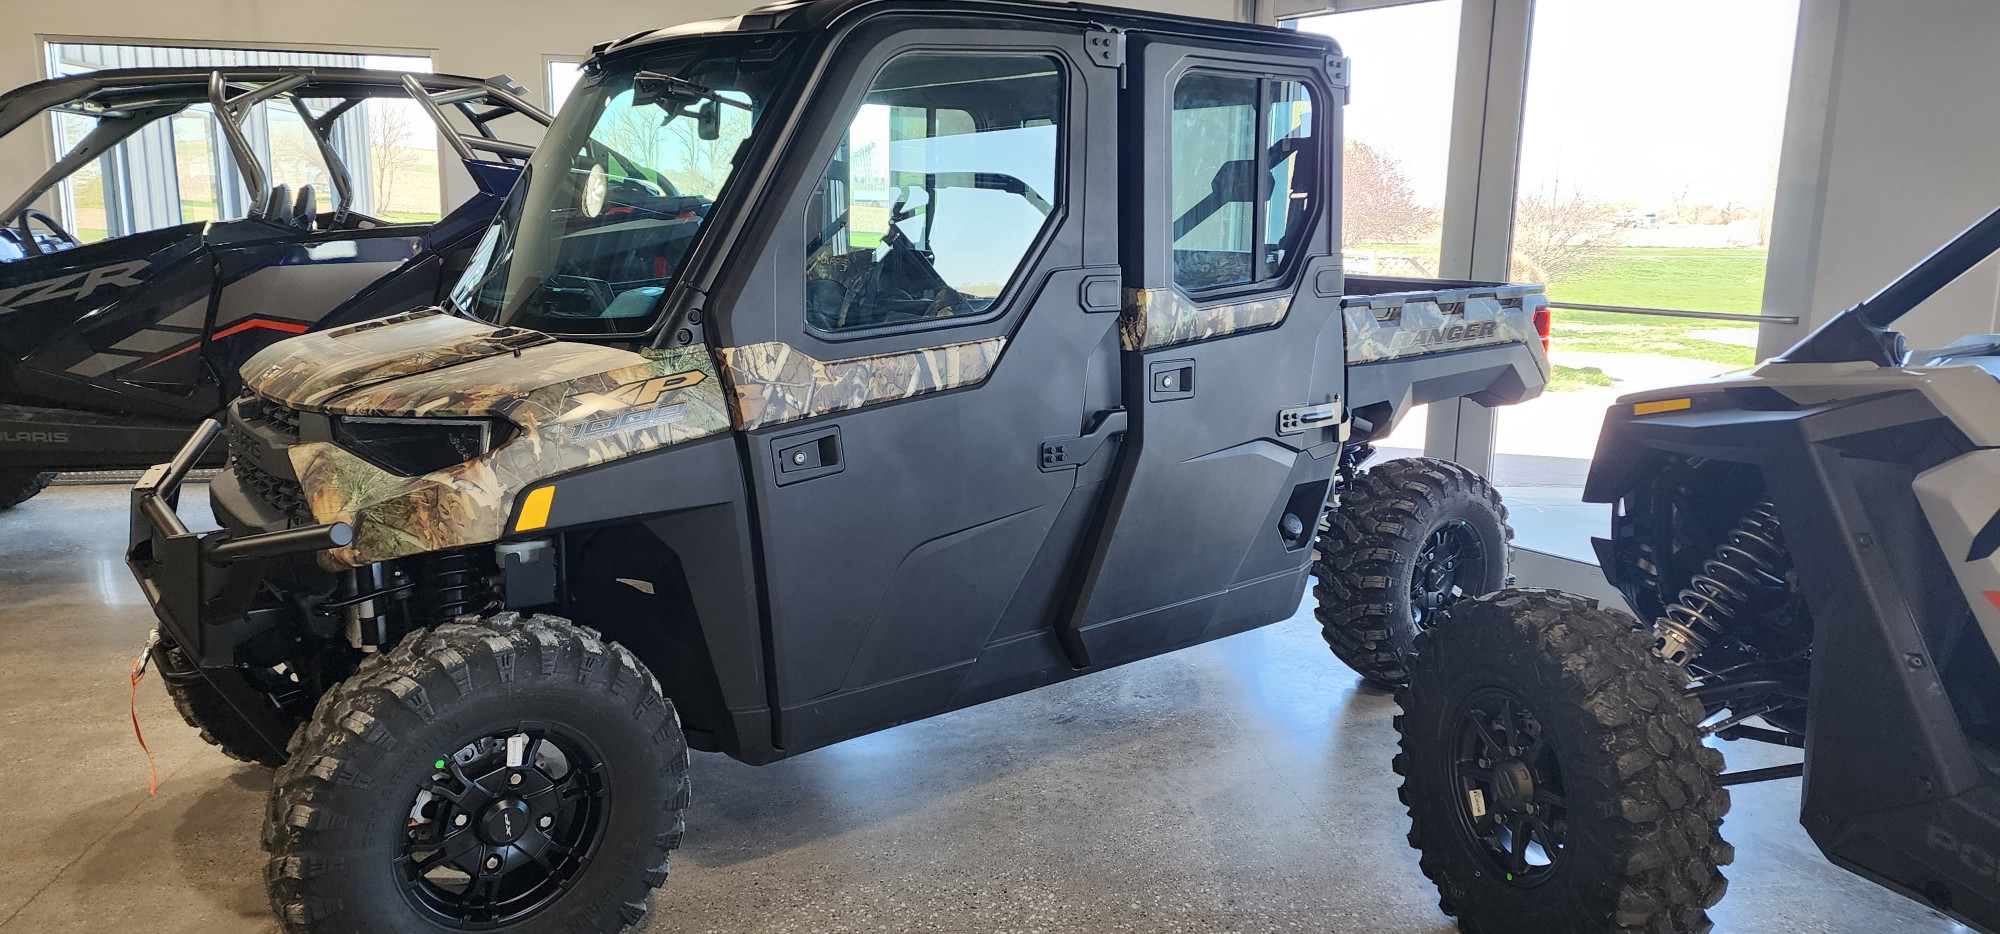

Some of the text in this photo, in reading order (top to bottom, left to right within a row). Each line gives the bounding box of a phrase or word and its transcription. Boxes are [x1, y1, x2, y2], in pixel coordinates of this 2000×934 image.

[1389, 320, 1497, 350] RANGER
[539, 369, 709, 429] XP
[0, 431, 68, 443] LARIS
[570, 401, 688, 439] 1000
